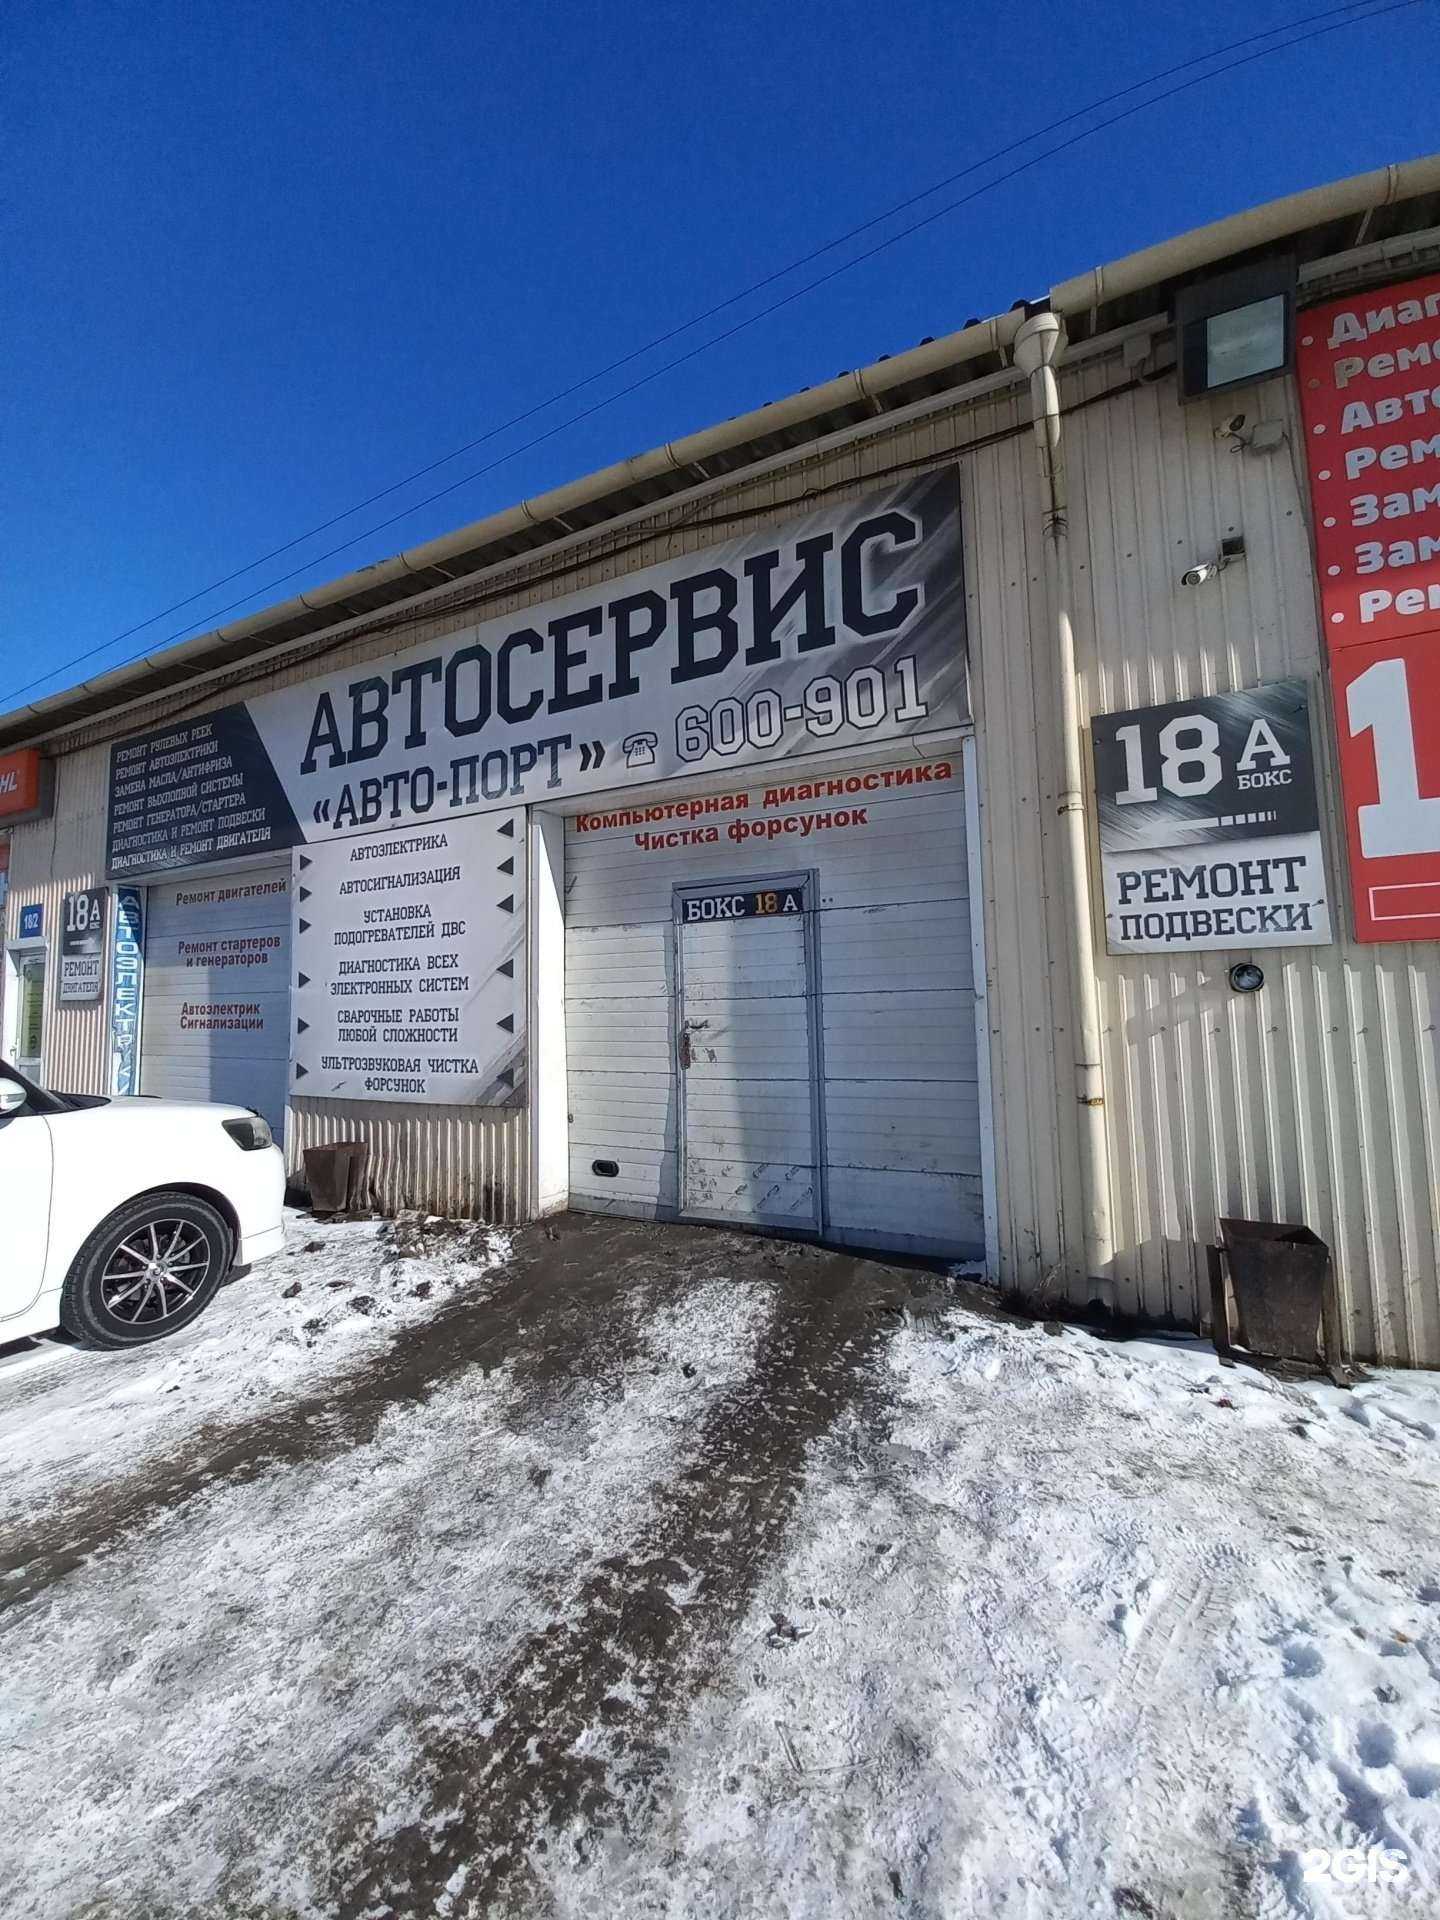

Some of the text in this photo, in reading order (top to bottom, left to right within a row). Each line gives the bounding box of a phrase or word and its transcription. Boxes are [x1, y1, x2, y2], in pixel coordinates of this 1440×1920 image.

[1334, 339, 1440, 389] Рем
[301, 512, 925, 775] АВТОСЕРВИС
[116, 723, 213, 763] РЕМОНТ РУЛЕВЫХ РЕЕК
[314, 655, 929, 830] «АВТО-ПОРТ» 600-901
[115, 740, 219, 780] РЕМОНТ АВТОЭЛЕКТРИКИ
[1115, 714, 1291, 806] 18 А
[114, 755, 232, 798] ЗАМЕНА МАСЛА/АНТИФРИЗА
[1237, 769, 1293, 790] БОКС
[114, 772, 244, 816] РЕМОНТ ВЫХЛОПНОЙ СИСТЕМЫ
[576, 761, 952, 833] Компьютерная диагностика
[113, 792, 246, 834] РЕМОНТ ГЕНЕРАТОРА/СТАРТЕРА
[112, 808, 266, 853] ДИАГНОСТИКА И РЕМОНТ ПОДВЕСКИ
[635, 806, 868, 851] Чистка форсунок
[111, 826, 271, 871] ДИАГНОСТИКА И РЕМОНТ ДВИГАТЕЛЯ
[349, 834, 448, 862] АВТОЭЛЕКТРИКА
[176, 878, 287, 906] Ремонт двигателей
[339, 866, 461, 895] АВТОСИГНАЛИЗАЦИЯ
[1116, 855, 1306, 905] РЕМОНТ
[66, 894, 89, 932] 18
[363, 903, 432, 923] УСТАНОВКА
[687, 892, 798, 921] БОКС 18 А
[334, 921, 466, 945] ПОДОГРЕВАТЕЛЕЙ ДВС
[1120, 902, 1313, 942] ПОДВЕСКИ
[178, 936, 281, 955] Ремонт стартеров
[64, 960, 100, 977] РЕМОНТ
[186, 952, 268, 969] и генераторов
[338, 954, 459, 976] ДИАГНОСТИКА ВСЕХ
[330, 976, 469, 995] ЭЛЕКТРОННЫХ СИСТЕМ
[180, 1016, 264, 1032] Сигнализации
[181, 1001, 260, 1018] Автоэлектрик
[337, 1008, 459, 1023] СВАРОЧНЫЕ РАБОТЫ
[337, 1025, 458, 1042] ЛЮБОЙ СЛОЖНОСТИ
[321, 1056, 479, 1074] УЛЬТРОЗВУКОВАЯ ЧИСТКА
[364, 1077, 426, 1094] ФОРСУНОК
